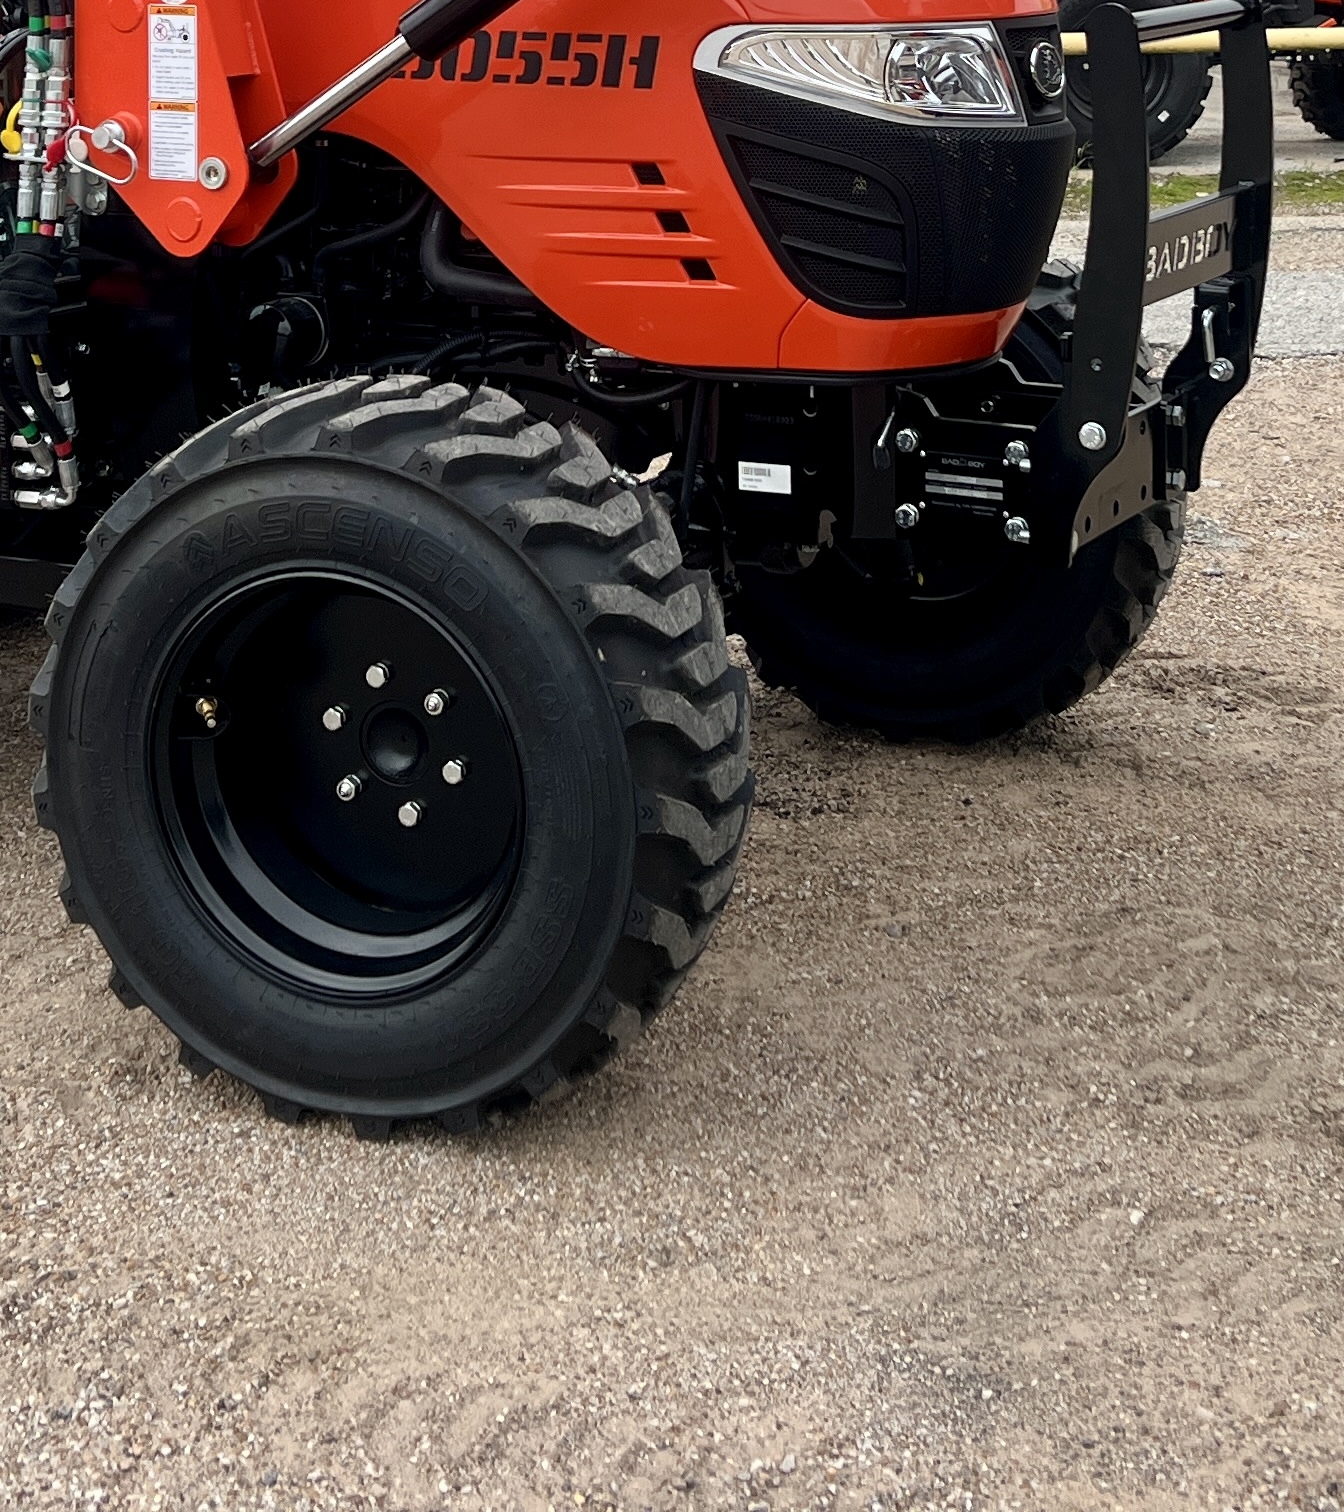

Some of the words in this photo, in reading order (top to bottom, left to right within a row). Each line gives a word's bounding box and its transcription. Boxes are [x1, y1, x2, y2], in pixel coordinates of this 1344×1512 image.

[389, 29, 660, 90] 055H
[1145, 234, 1190, 282] BAD
[1190, 221, 1234, 265] BOY
[222, 502, 490, 614] ASCENSO
